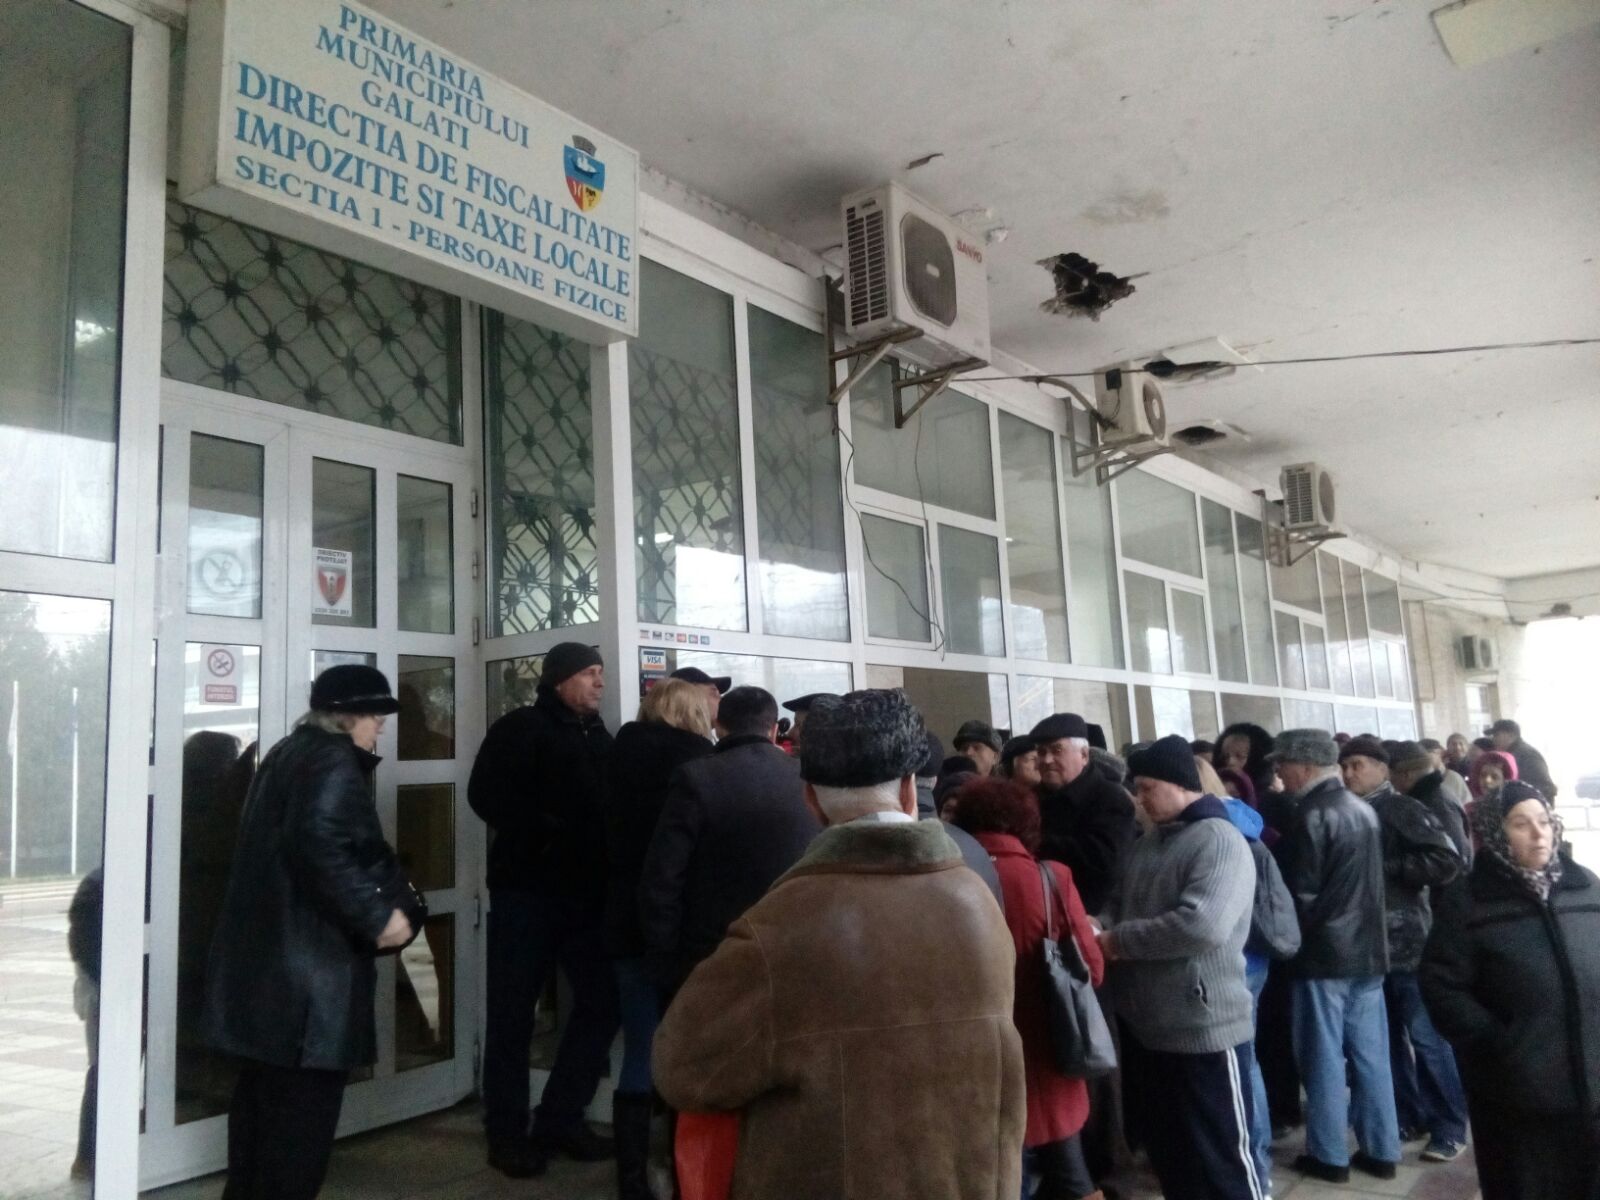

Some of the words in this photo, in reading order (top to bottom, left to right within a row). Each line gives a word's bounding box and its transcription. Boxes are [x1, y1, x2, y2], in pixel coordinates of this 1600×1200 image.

[316, 26, 529, 148] MUNICIPIULUI
[340, 5, 485, 100] PRIMARIA
[237, 62, 407, 162] DIRECTIA
[416, 141, 458, 184] DE
[465, 164, 631, 262] FISCALITATE
[361, 81, 470, 150] GALATI
[234, 108, 409, 205] IMPOZITE
[416, 184, 445, 219] SI
[453, 199, 527, 253] TAXE
[533, 233, 631, 297] LOCALE
[235, 155, 361, 221] SECTIA
[408, 219, 545, 291] PERSOANE
[554, 280, 627, 323] FIZICE
[956, 240, 983, 263] SANYO
[647, 656, 662, 664] VISA
